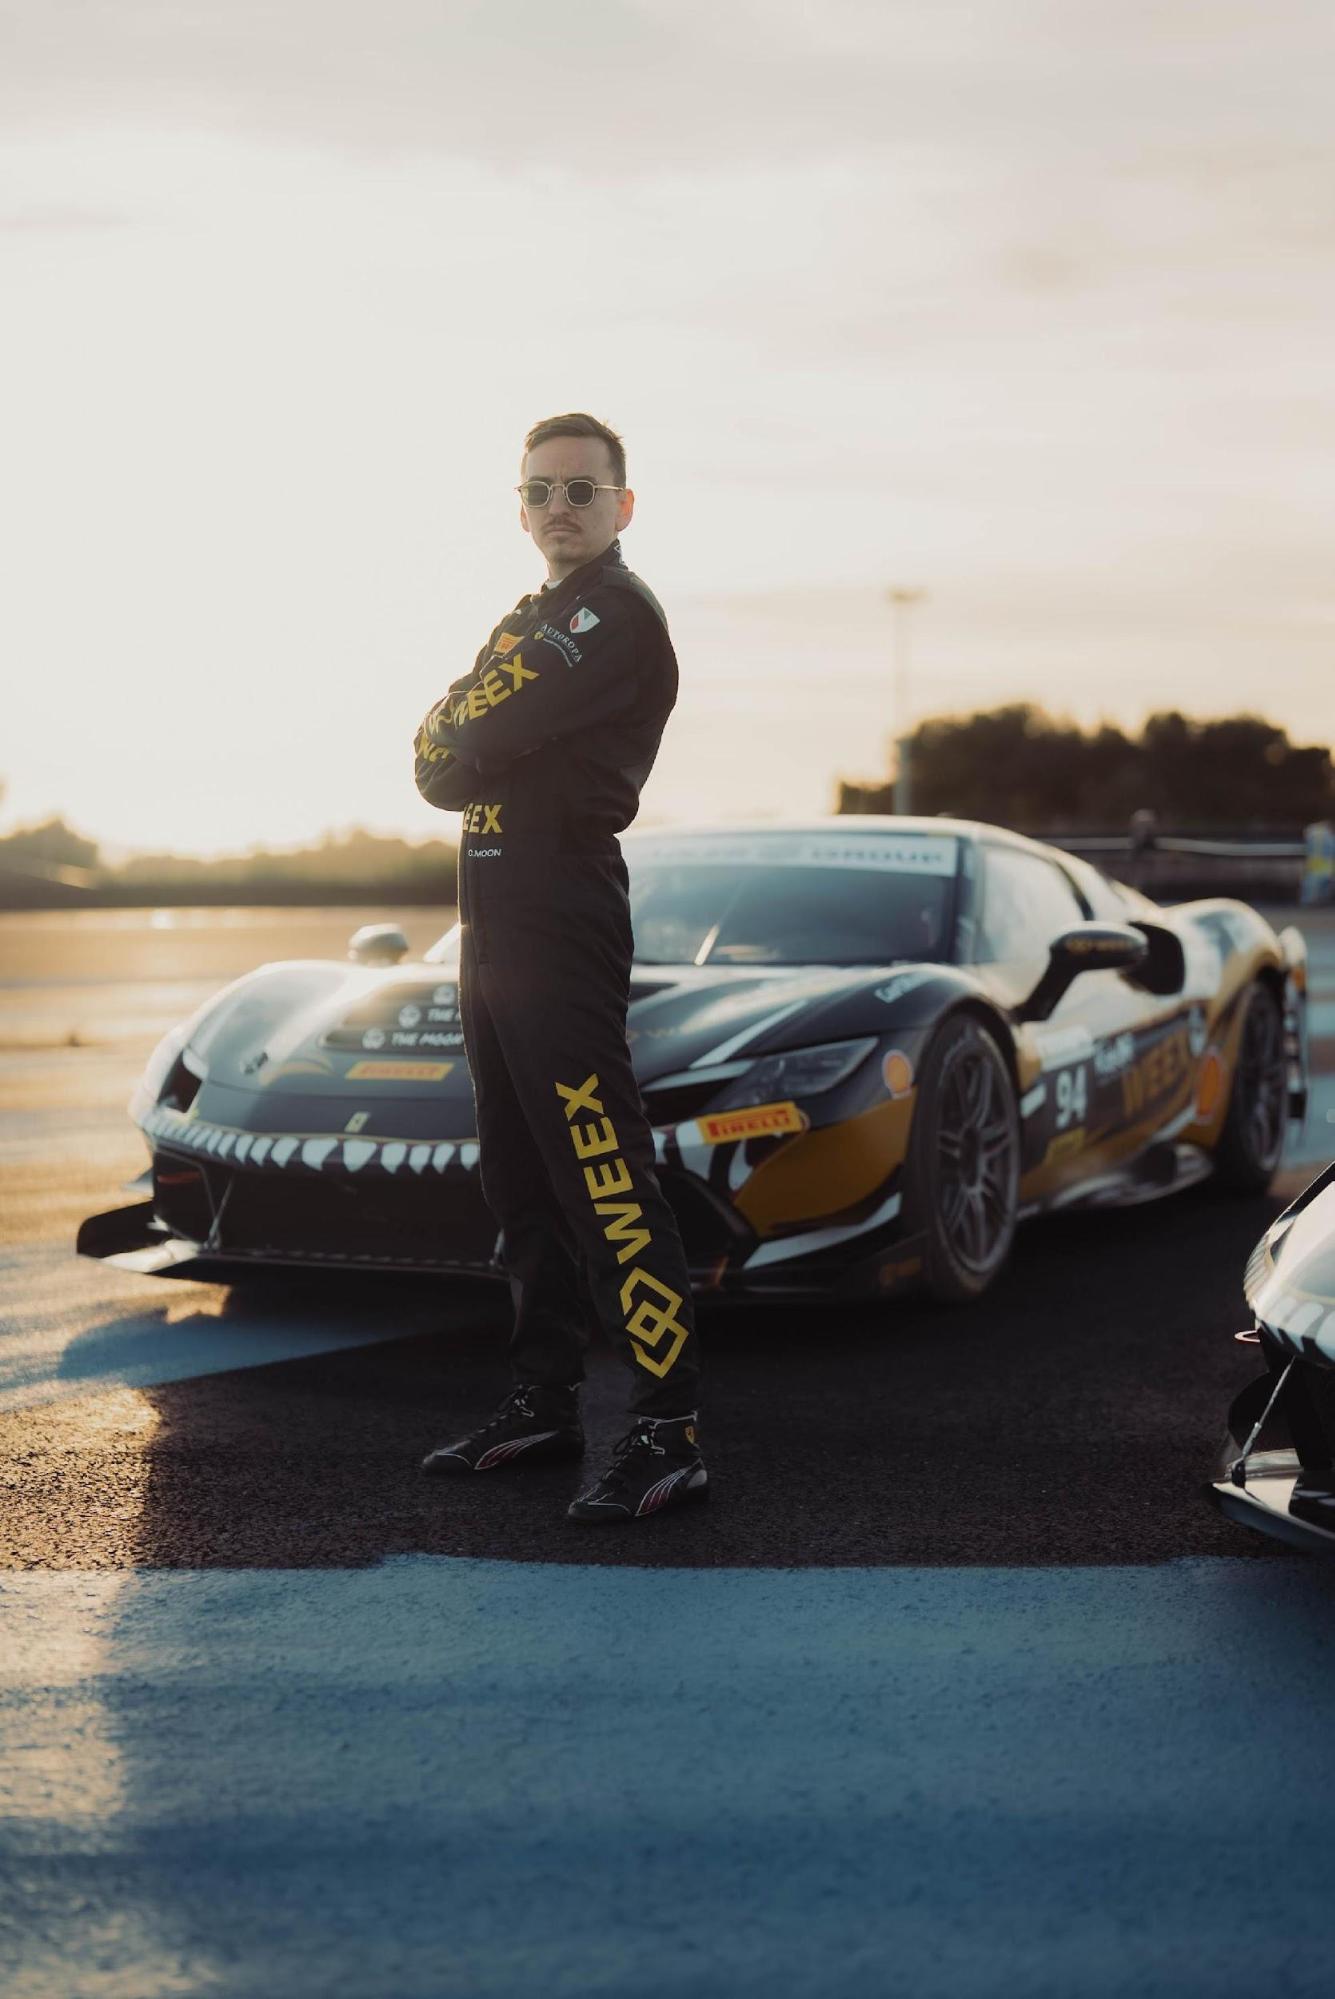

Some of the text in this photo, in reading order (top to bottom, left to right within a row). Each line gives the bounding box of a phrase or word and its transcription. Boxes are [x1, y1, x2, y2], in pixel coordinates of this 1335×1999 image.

[463, 802, 504, 834] EEX
[1054, 1064, 1088, 1130] 94
[706, 1108, 790, 1138] PIRELLI
[555, 1073, 652, 1265] WEEX
